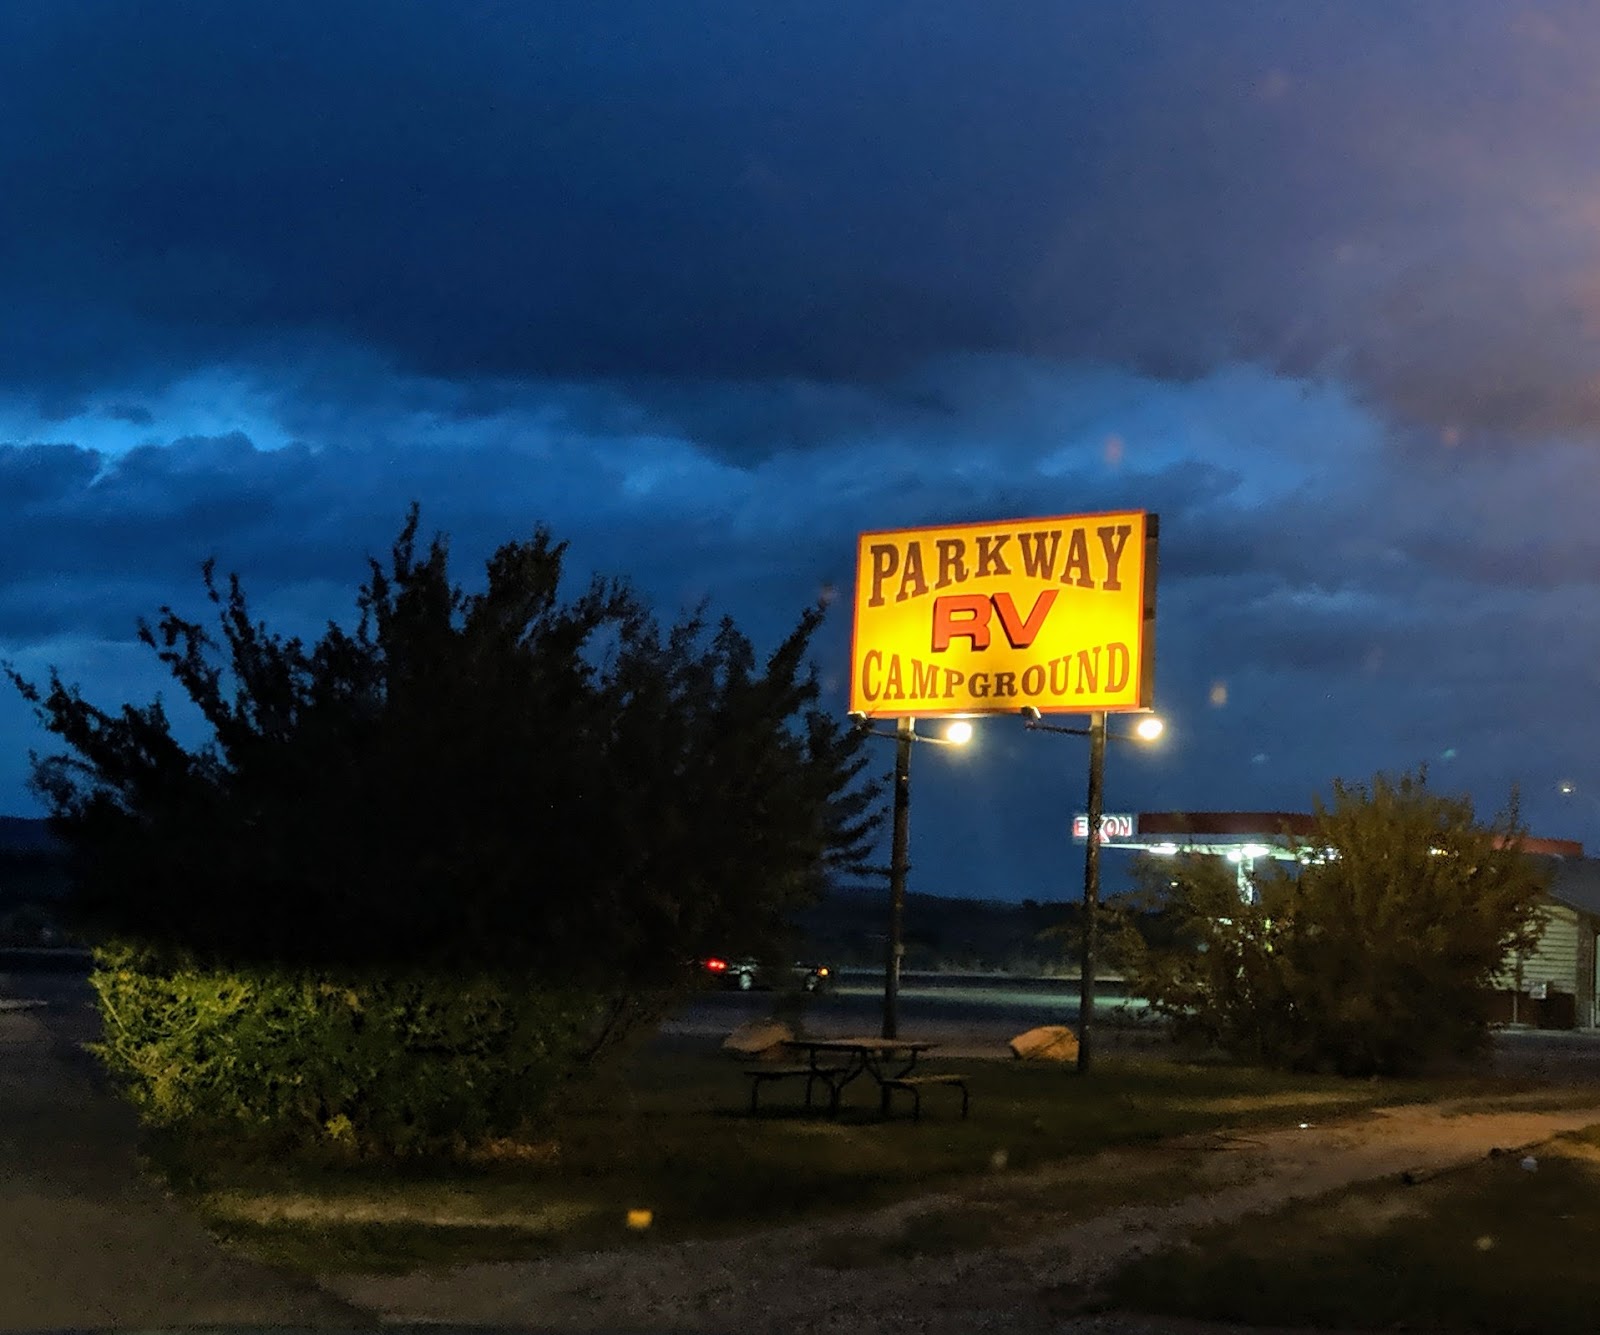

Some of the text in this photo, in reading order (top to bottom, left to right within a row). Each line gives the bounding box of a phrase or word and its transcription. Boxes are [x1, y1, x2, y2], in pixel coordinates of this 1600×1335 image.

[868, 525, 1131, 607] PARKWAY
[931, 589, 1059, 652] RV
[862, 642, 1130, 701] CAMPGROUND
[1073, 815, 1132, 843] EXON
